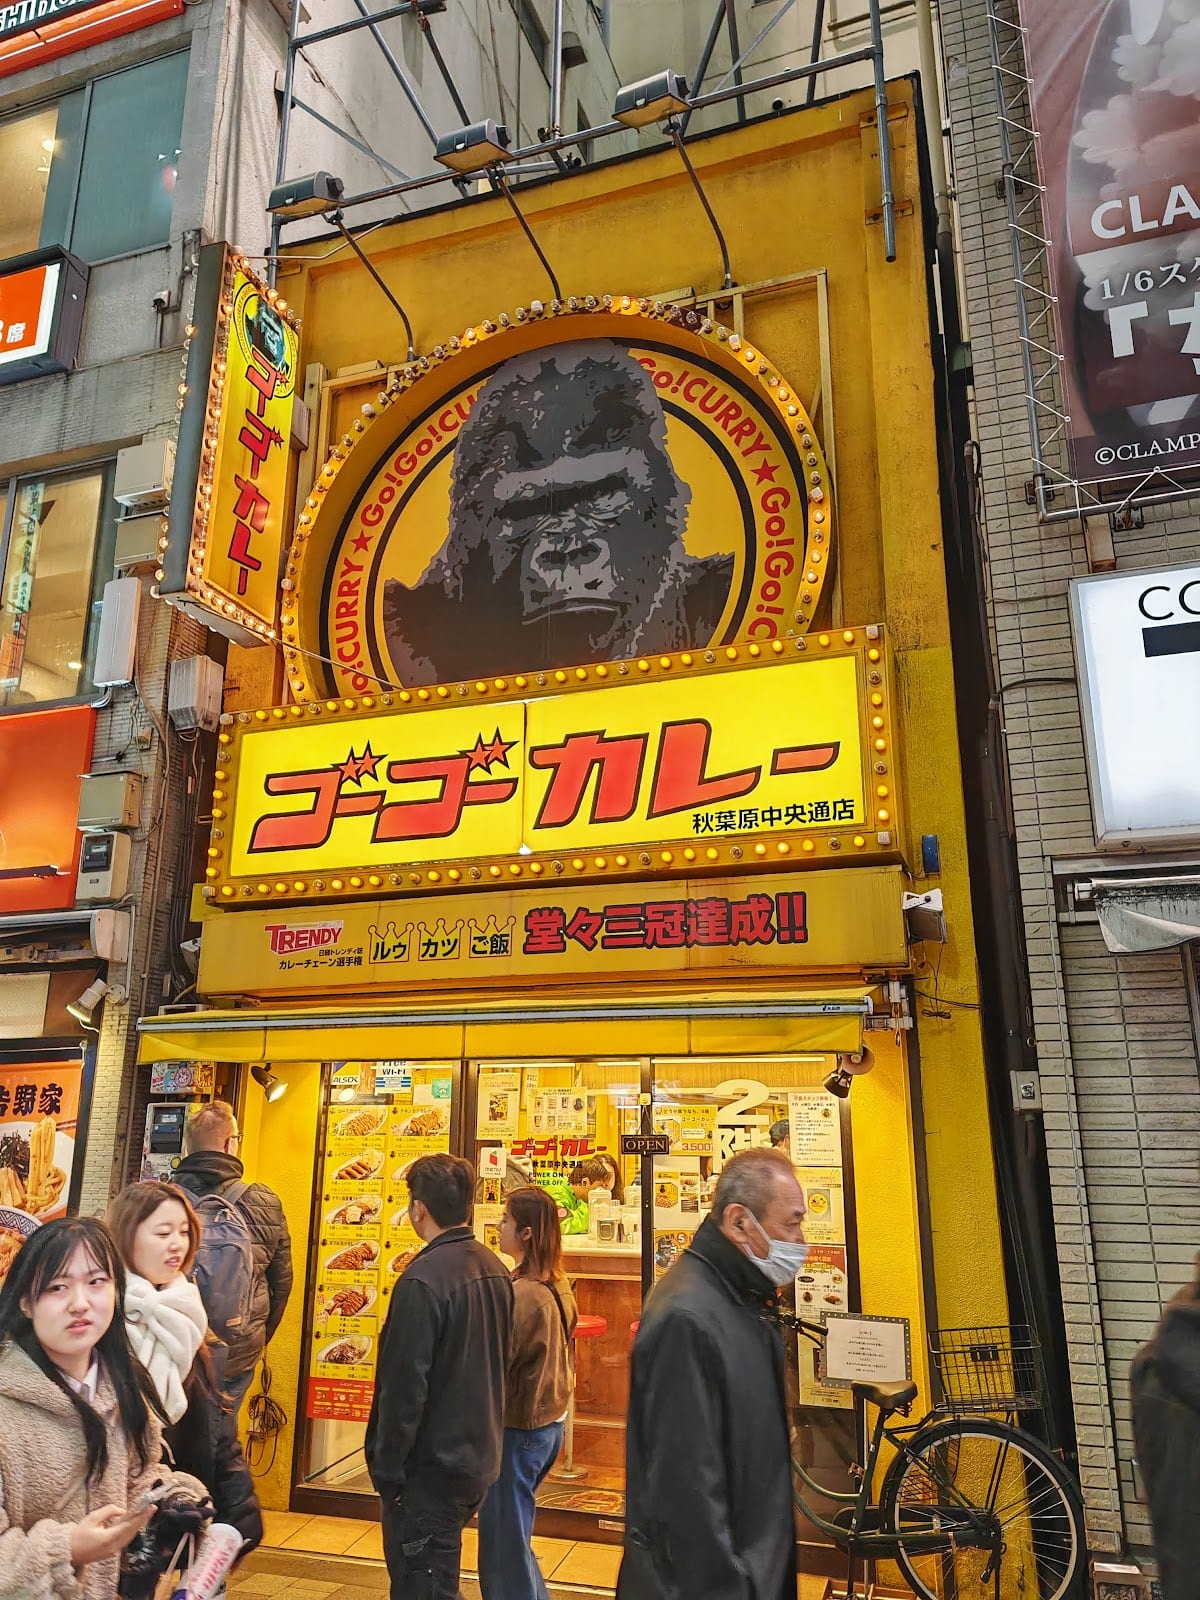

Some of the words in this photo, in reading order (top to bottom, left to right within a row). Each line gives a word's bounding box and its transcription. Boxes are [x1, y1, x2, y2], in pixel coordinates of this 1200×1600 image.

[228, 344, 289, 595] ゴーゴーカレー
[247, 716, 842, 854] ゴーゴーカレー
[692, 799, 855, 835] 秋葉原中央通店
[265, 924, 343, 954] TRENDY
[421, 937, 458, 958] カツ
[471, 933, 510, 956] ご飯
[279, 956, 362, 970] カレーチェーン選手権
[510, 1137, 607, 1157] ゴーゴーカレー
[625, 1140, 666, 1151] OPEN
